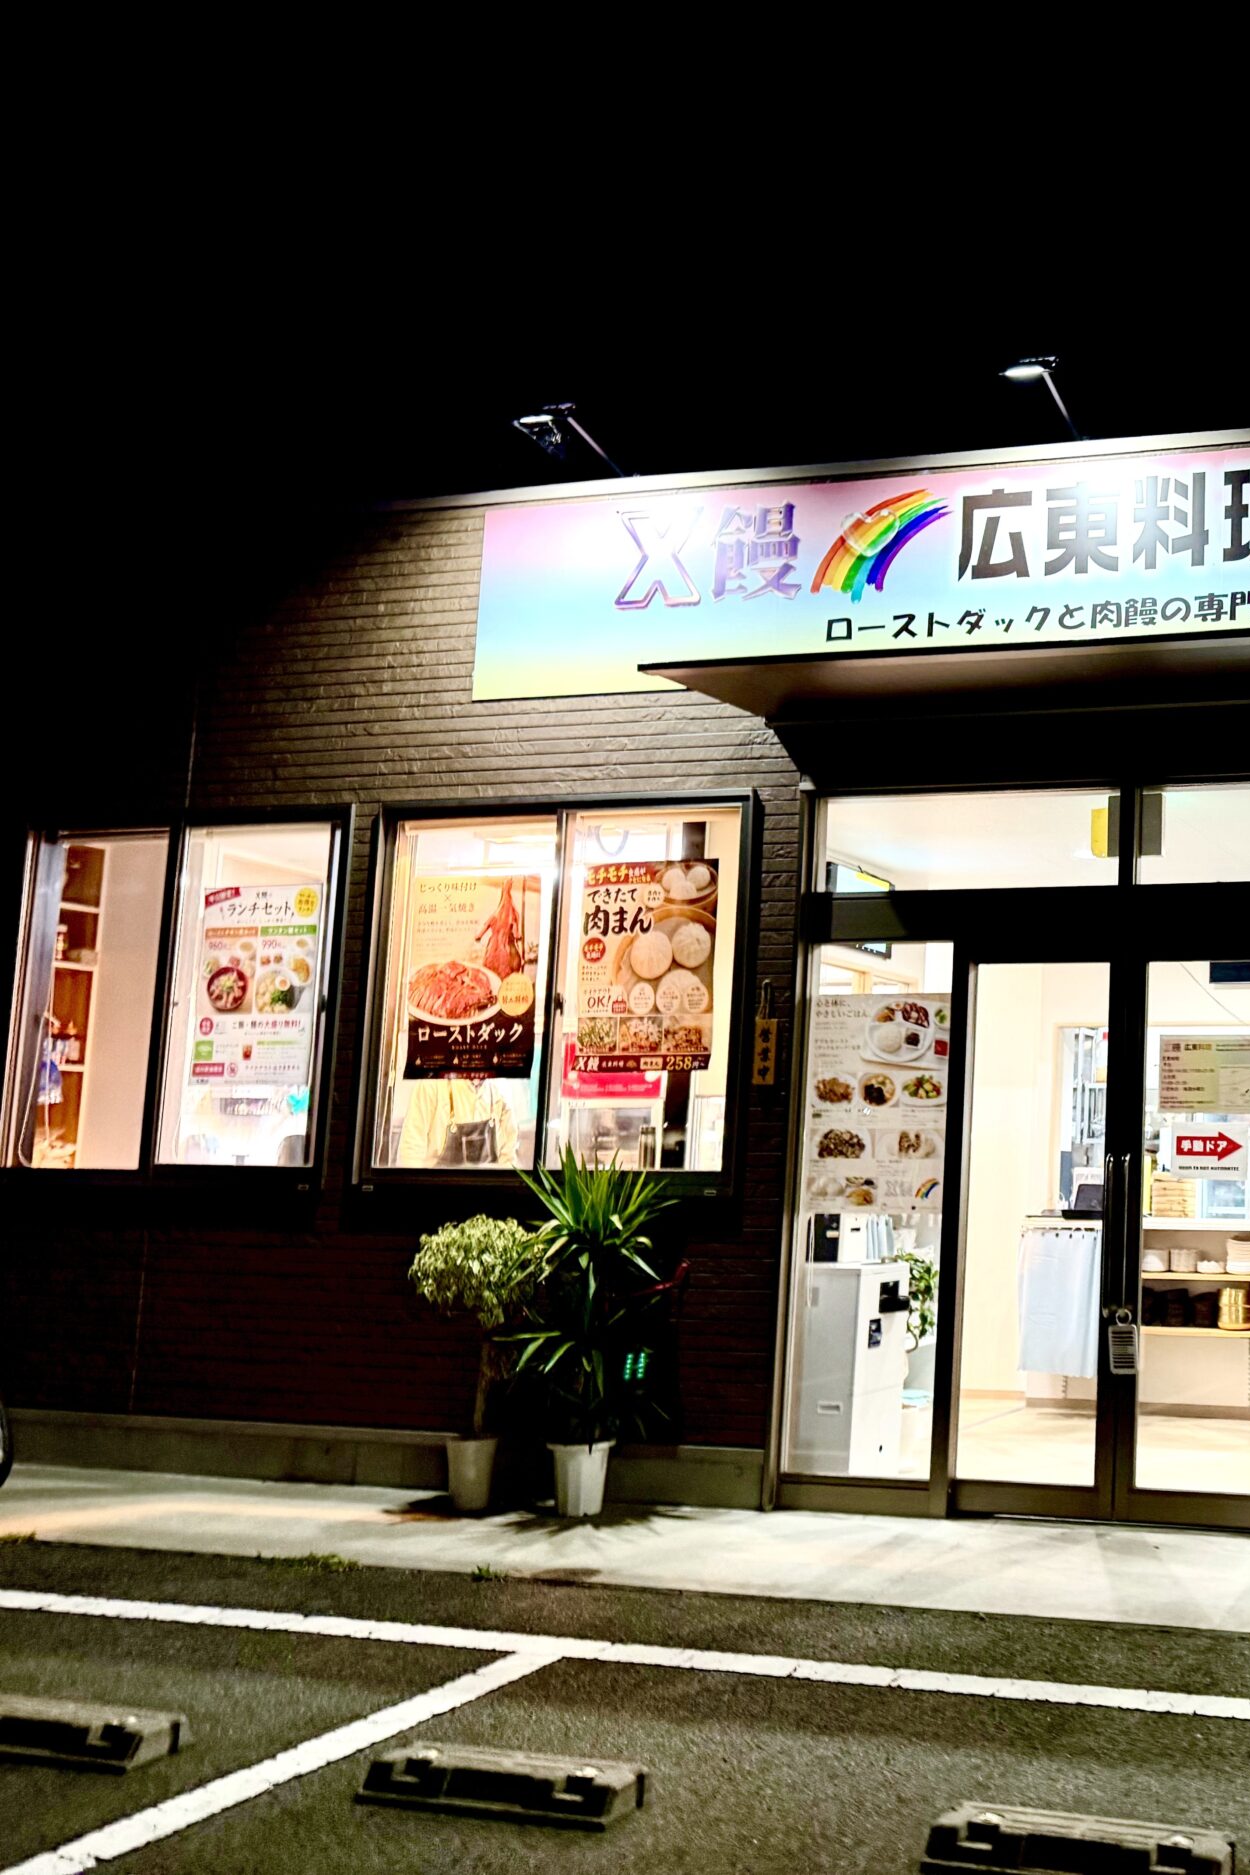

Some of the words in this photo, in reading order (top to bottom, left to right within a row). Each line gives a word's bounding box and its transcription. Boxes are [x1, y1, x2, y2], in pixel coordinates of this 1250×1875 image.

[587, 887, 638, 904] できたて
[583, 904, 653, 937] 肉まん
[587, 995, 612, 1009] OK!
[417, 1022, 524, 1045] ローストダック
[665, 1055, 692, 1071] 258
